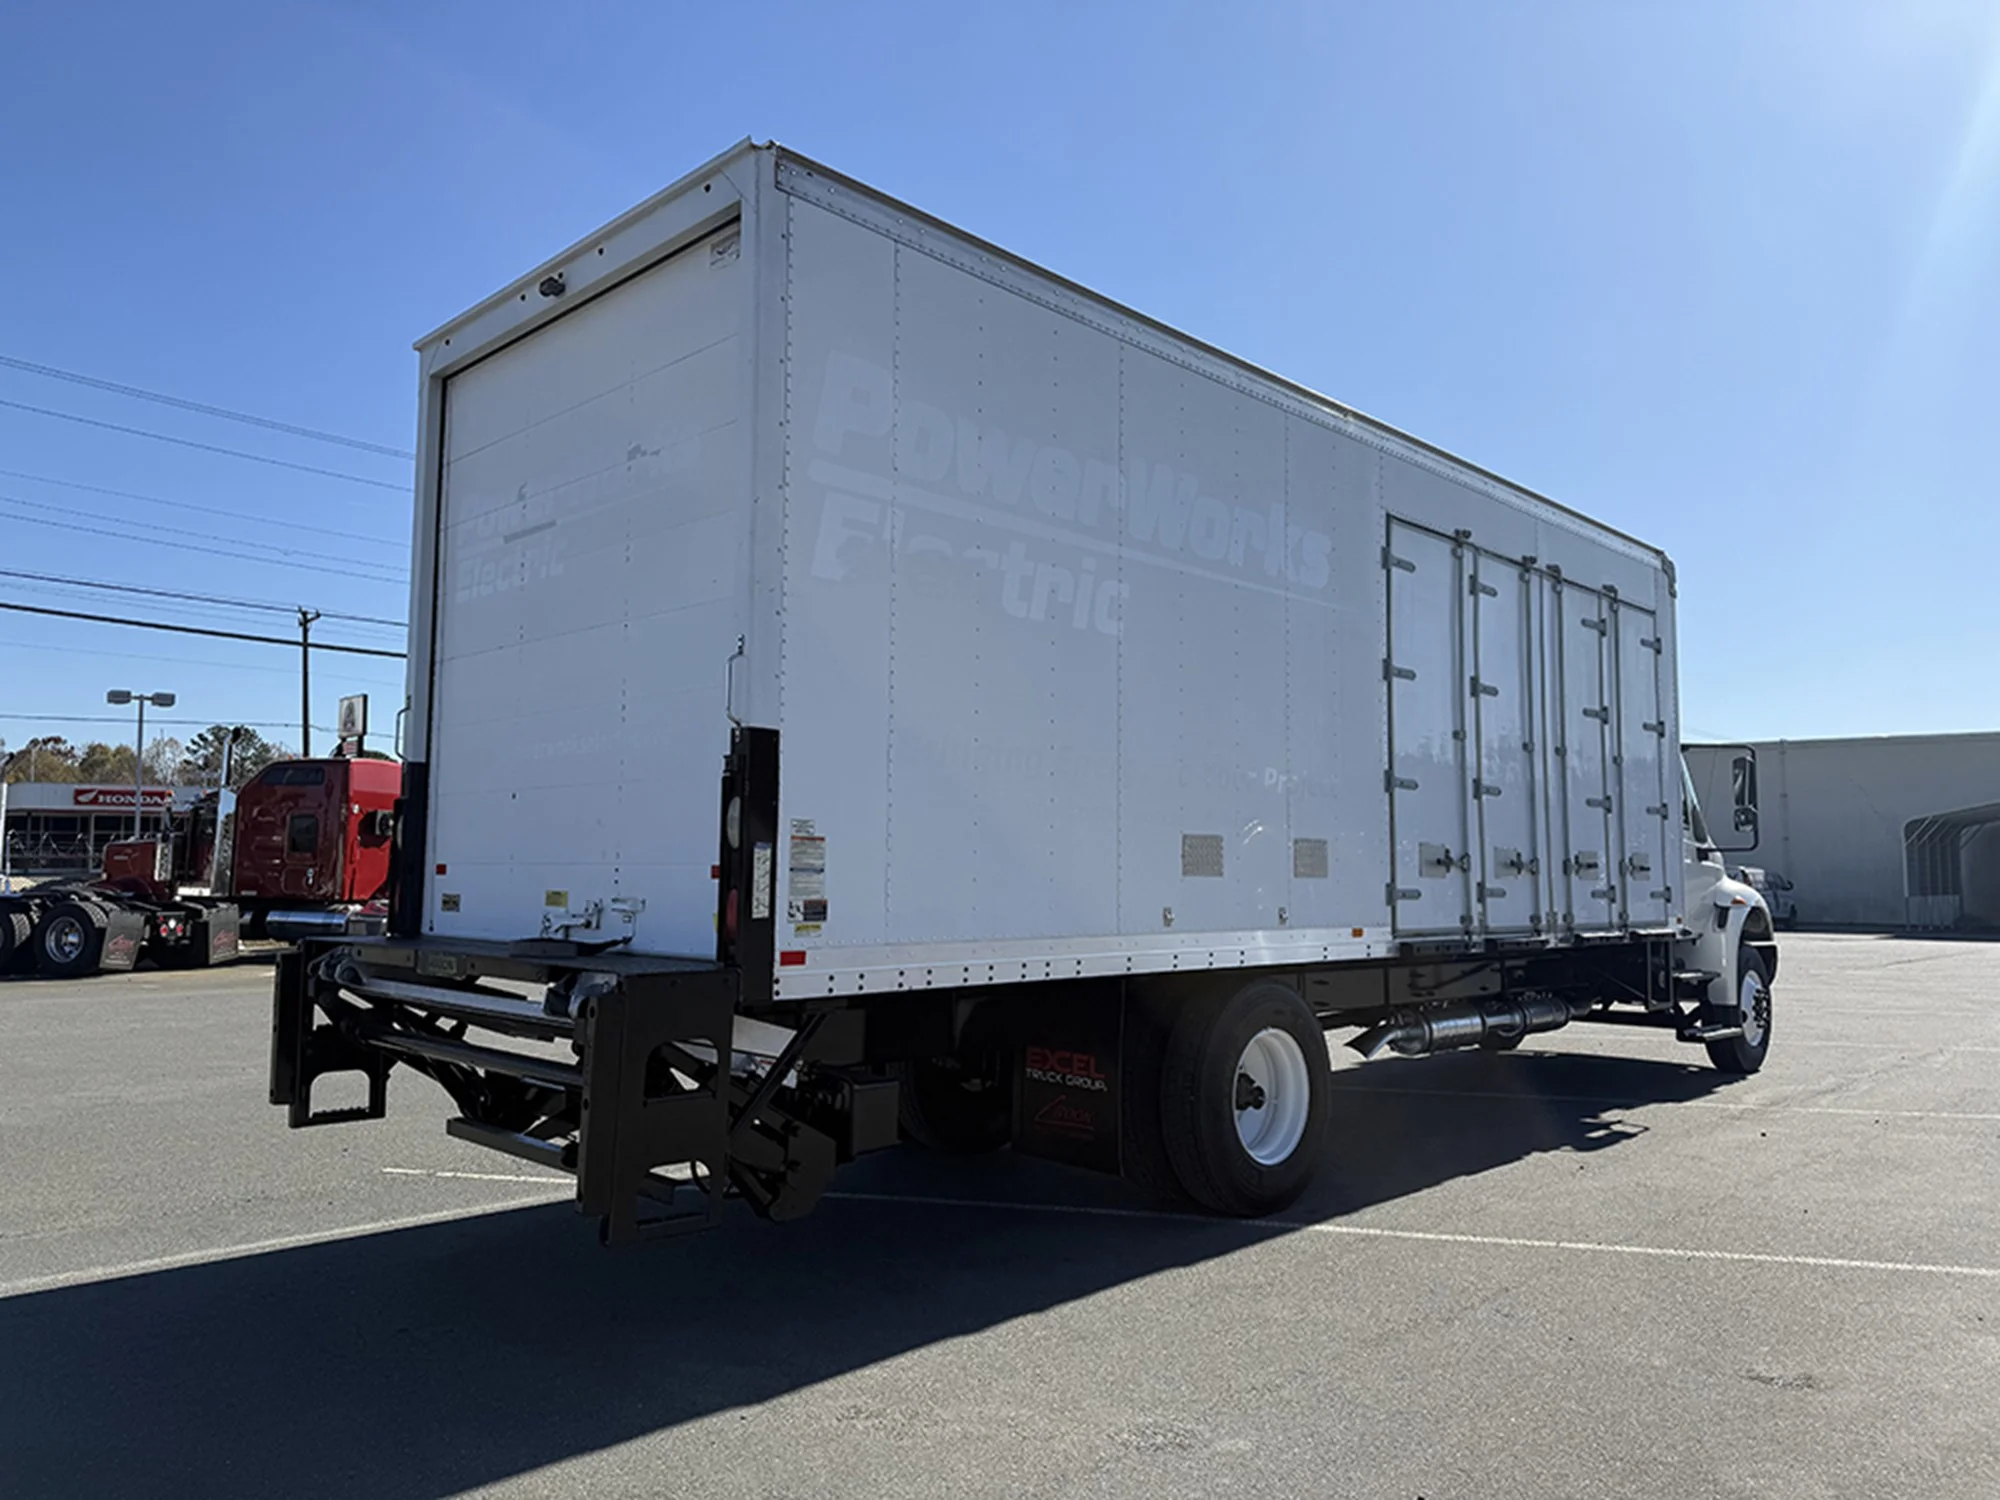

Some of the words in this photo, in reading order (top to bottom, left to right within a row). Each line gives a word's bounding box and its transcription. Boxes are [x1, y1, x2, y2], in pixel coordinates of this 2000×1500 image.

[98, 793, 165, 805] HONDA
[1026, 1046, 1105, 1079] EXCEL
[1025, 1067, 1063, 1084] TRUCK
